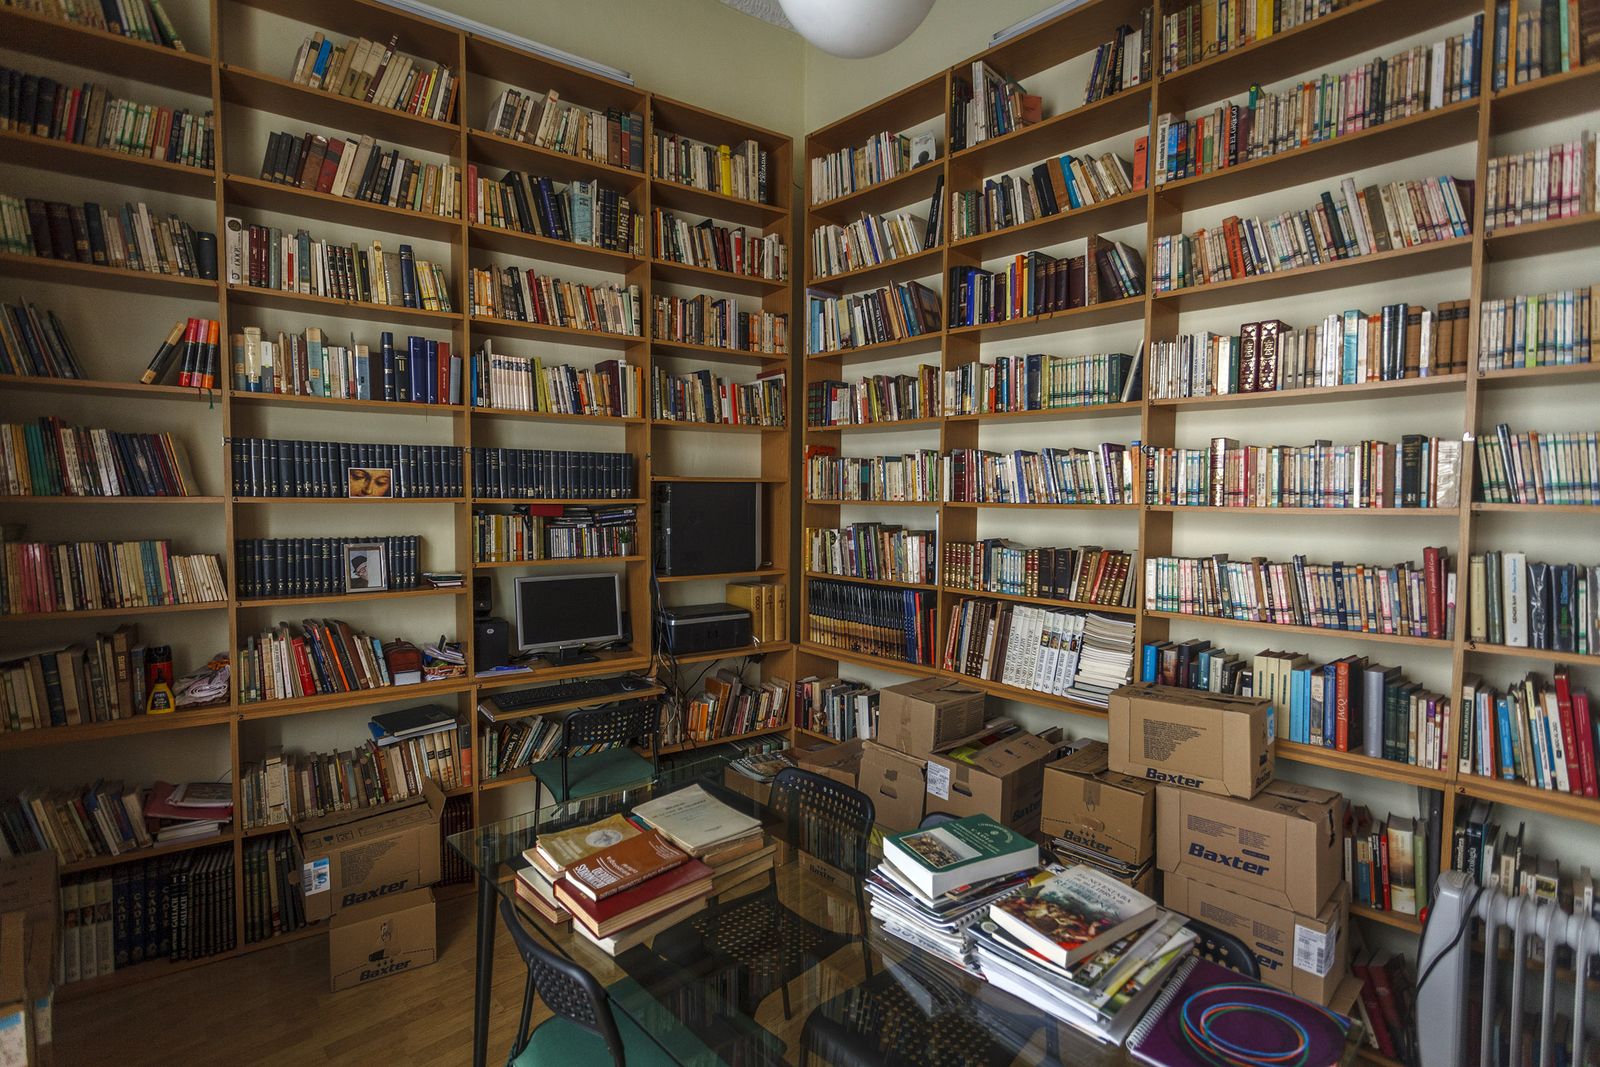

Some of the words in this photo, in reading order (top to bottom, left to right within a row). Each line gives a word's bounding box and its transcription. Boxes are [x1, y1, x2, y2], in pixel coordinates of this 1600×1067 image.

[1007, 626, 1016, 652] FLORENCIA
[1031, 635, 1039, 656] LOUVRE
[1337, 698, 1347, 721] JACQ
[1145, 767, 1204, 789] Baxter
[1064, 829, 1112, 853] Baxter
[1188, 842, 1270, 876] Baxter
[1467, 847, 1477, 875] Ecología
[808, 863, 836, 883] Baxter
[341, 879, 408, 908] Baxter
[148, 889, 156, 931] CADIZ
[359, 959, 411, 981] Baxter
